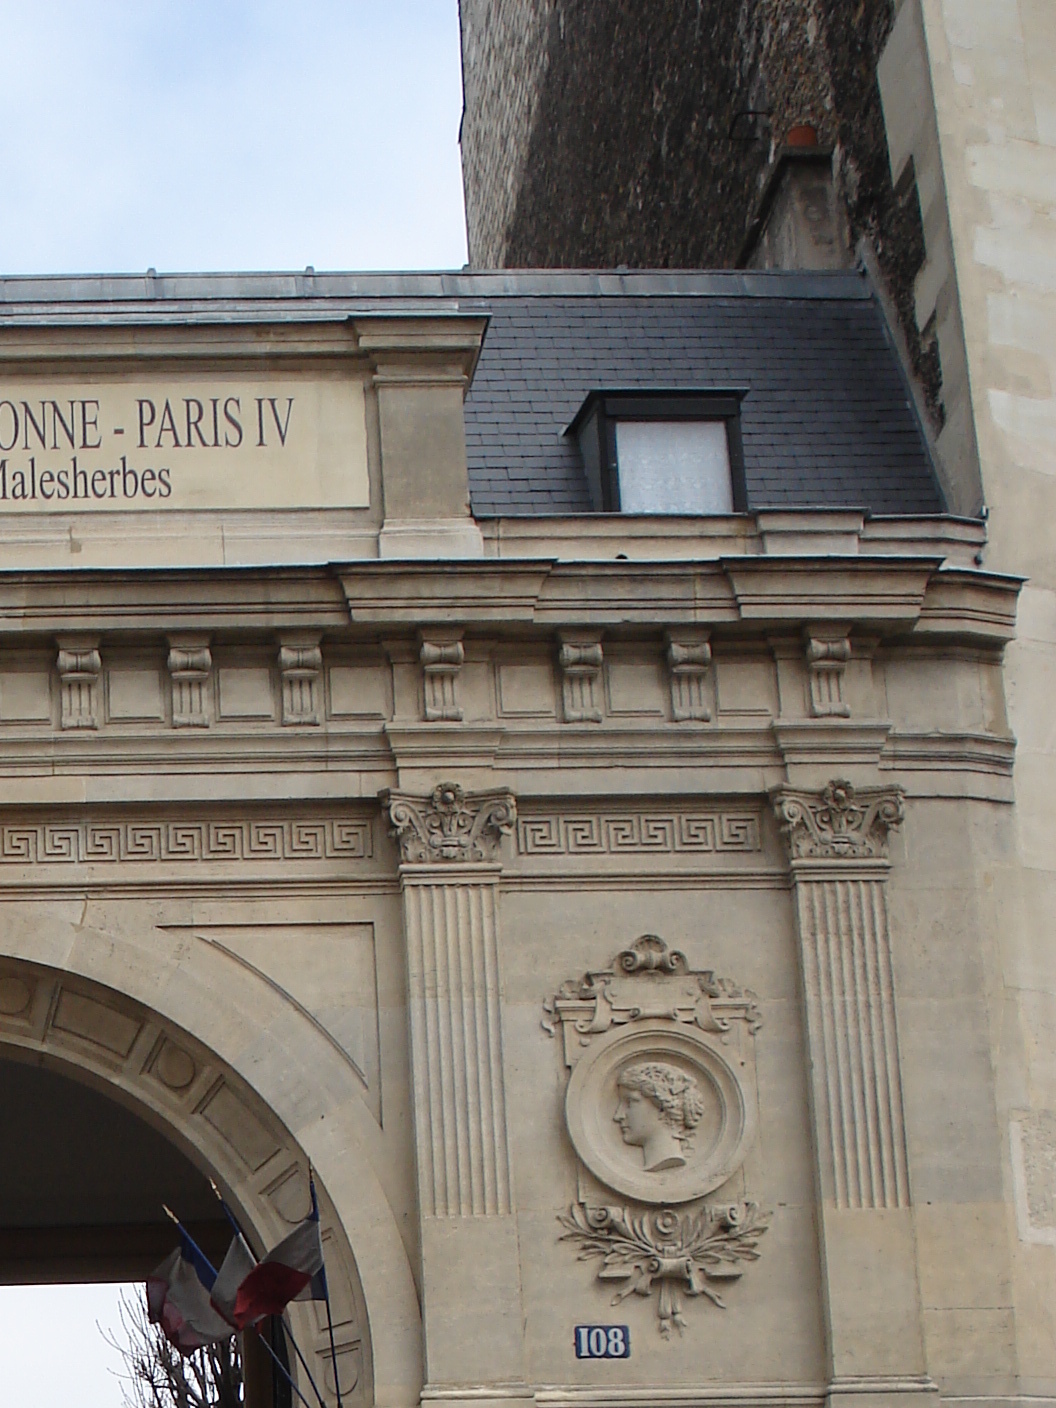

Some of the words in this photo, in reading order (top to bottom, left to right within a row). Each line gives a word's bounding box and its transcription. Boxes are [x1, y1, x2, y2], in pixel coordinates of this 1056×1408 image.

[136, 397, 244, 448] PARIS
[254, 397, 295, 448] IV
[578, 1327, 626, 1357] 108
